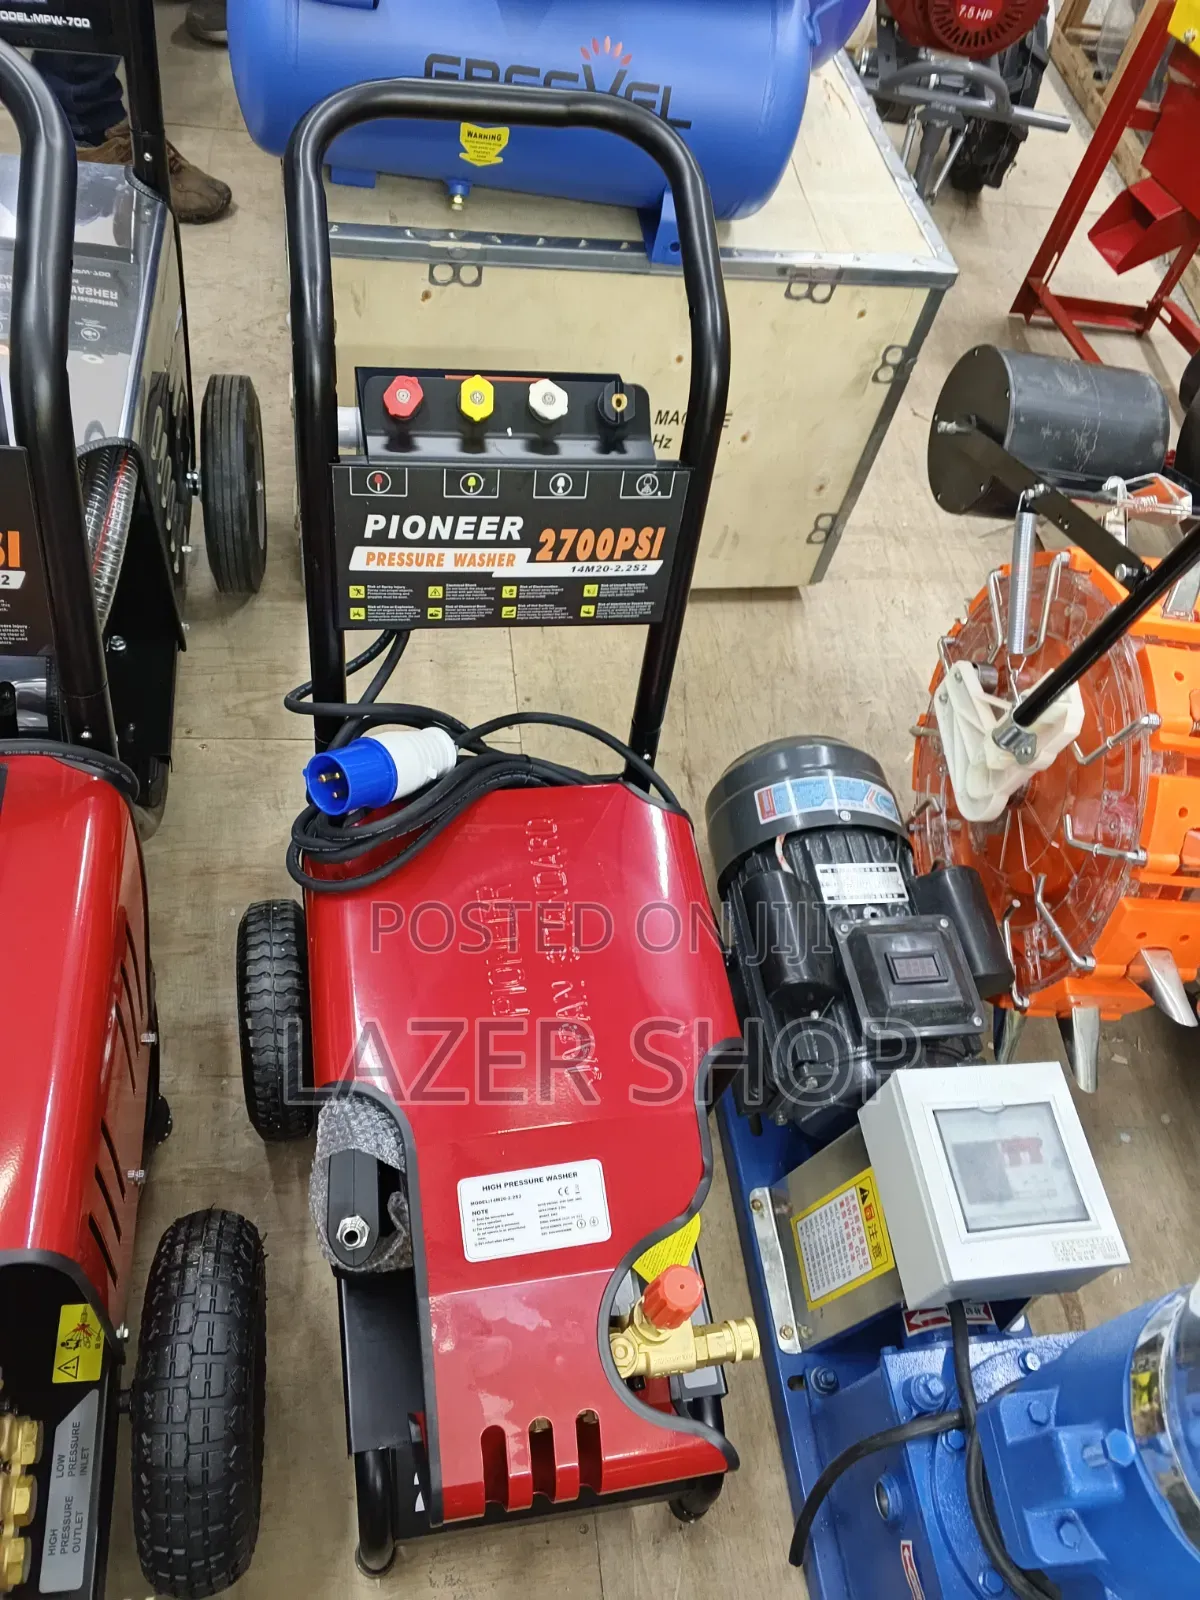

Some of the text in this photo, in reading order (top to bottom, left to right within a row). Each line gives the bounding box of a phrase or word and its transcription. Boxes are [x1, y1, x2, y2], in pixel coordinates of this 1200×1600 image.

[976, 8, 993, 21] HP
[467, 130, 502, 141] WARNING
[364, 514, 524, 541] PIONEER
[535, 526, 667, 562] 2700PSI
[365, 551, 517, 568] PRESSURE WASHER
[571, 564, 648, 573] 14M20-2.2S2
[482, 1171, 578, 1192] HIGH PRESSURE WASHER
[472, 1208, 489, 1216] NOTE
[68, 1421, 81, 1477] PRESSURE
[80, 1446, 90, 1476] INLET
[55, 1454, 66, 1479] LOW
[60, 1495, 74, 1555] PRESSURE
[72, 1510, 84, 1554] OUTLET
[47, 1528, 58, 1557] HIGH
